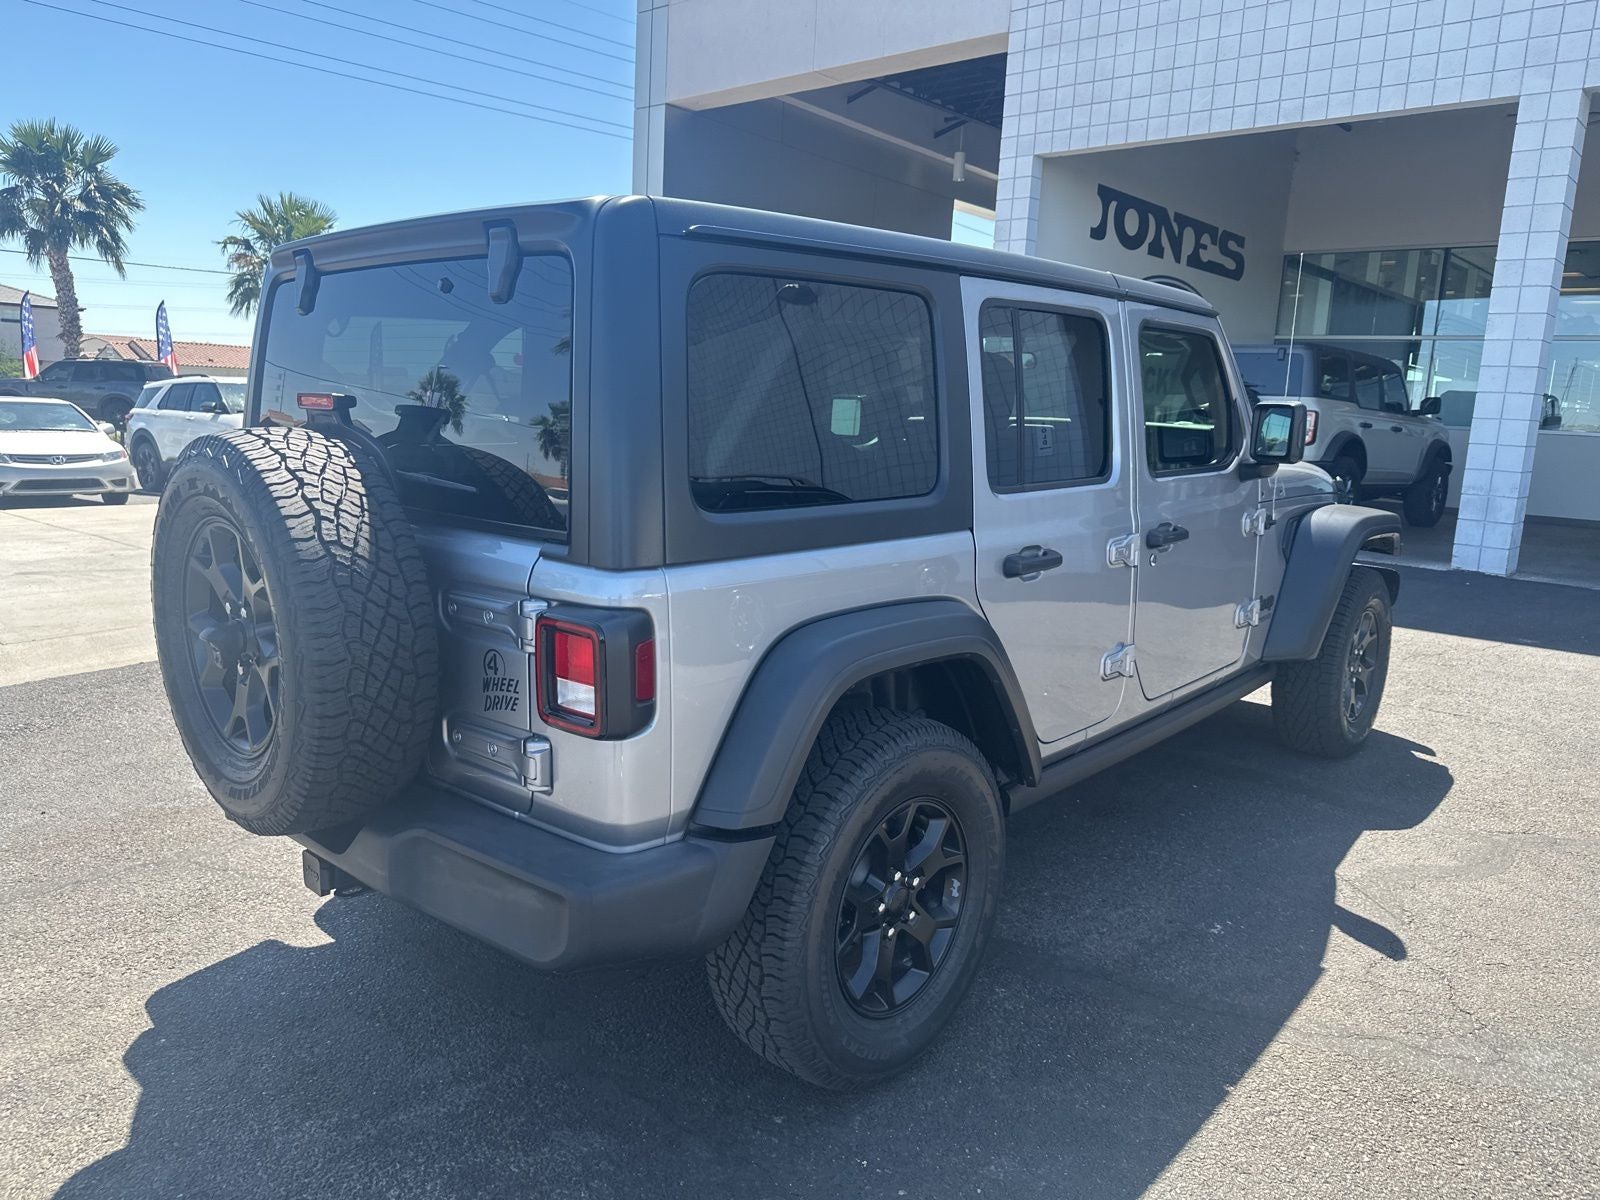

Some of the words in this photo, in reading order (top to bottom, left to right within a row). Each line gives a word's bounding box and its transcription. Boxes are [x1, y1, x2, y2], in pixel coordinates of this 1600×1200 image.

[1089, 183, 1246, 281] JONES
[486, 652, 501, 676] 4
[482, 677, 519, 694] WHEEL
[484, 694, 519, 712] DRIVE
